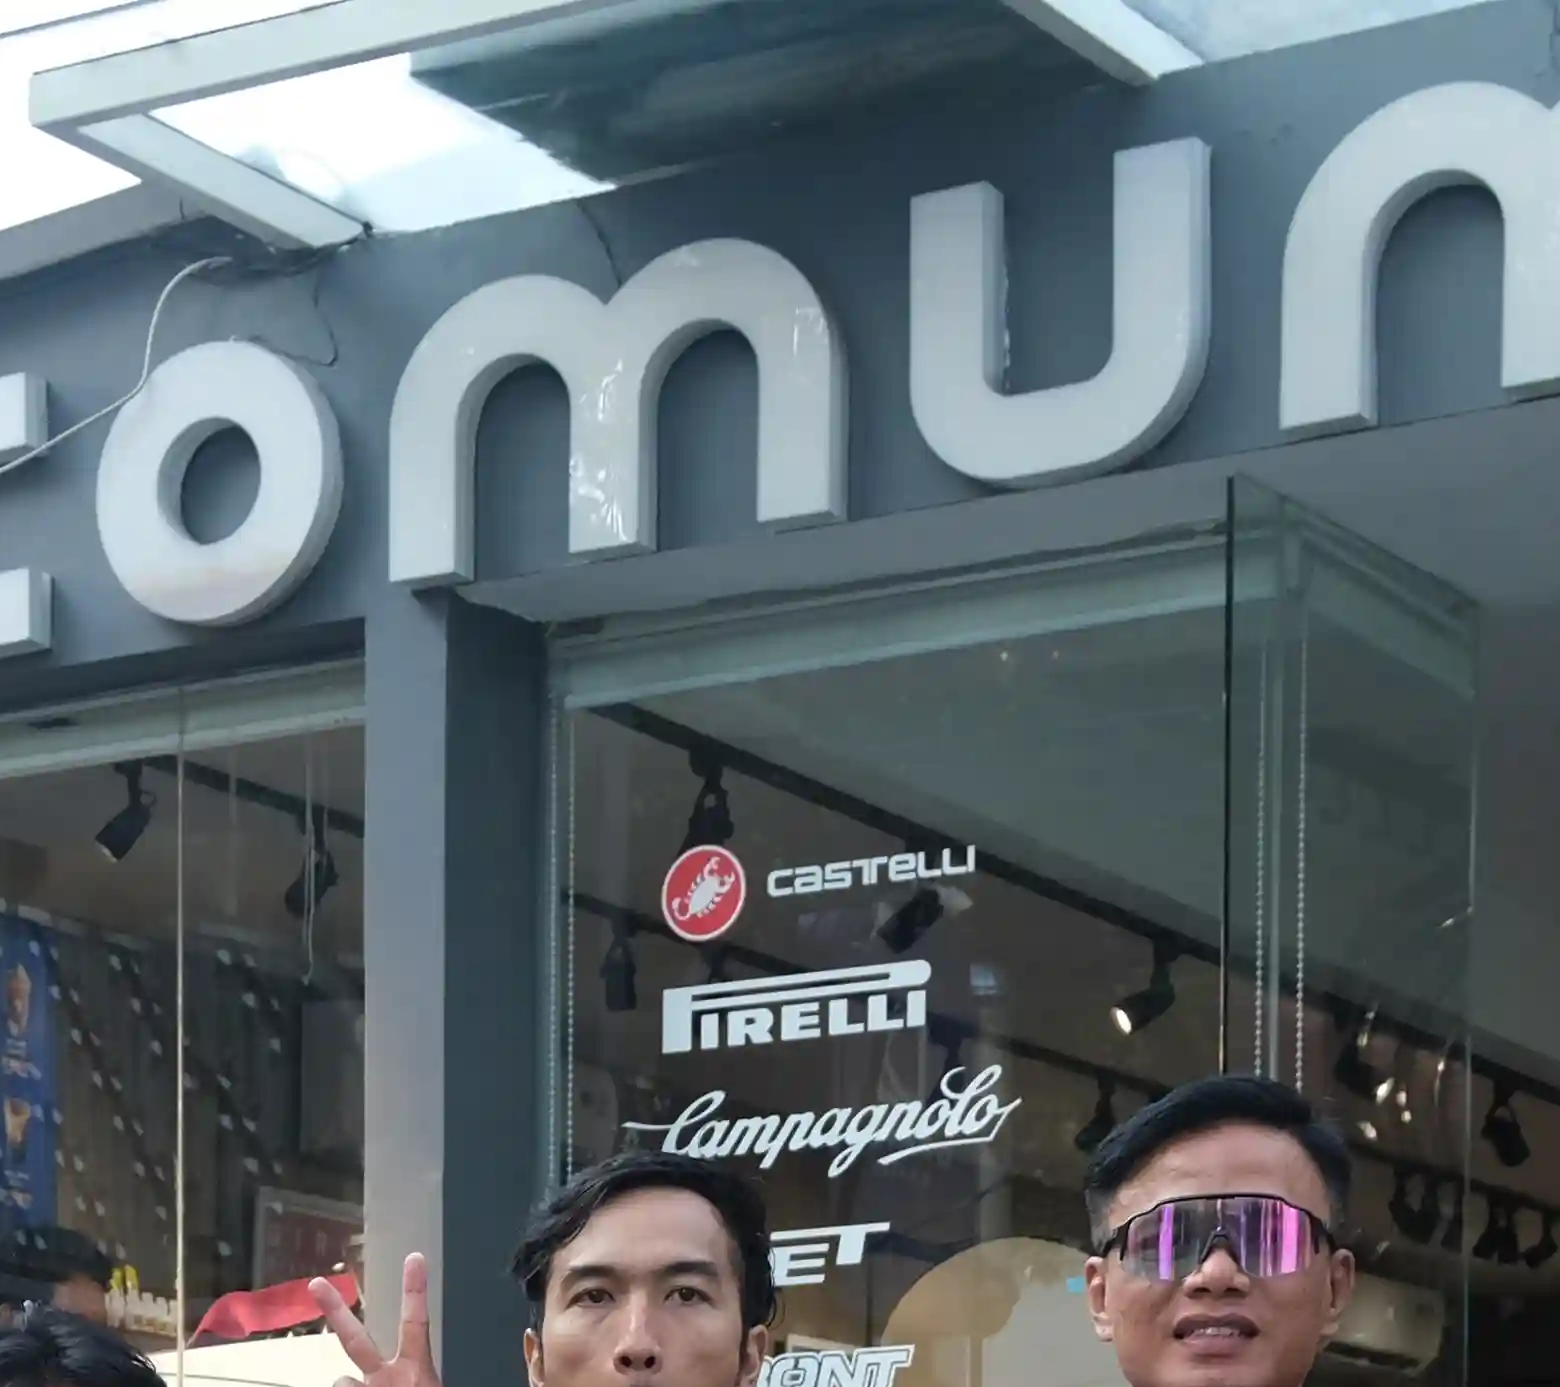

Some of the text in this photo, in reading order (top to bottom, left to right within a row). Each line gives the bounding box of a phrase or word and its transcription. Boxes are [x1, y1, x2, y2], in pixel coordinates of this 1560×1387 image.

[662, 960, 932, 1054] PIRELLI
[622, 1064, 1022, 1178] Campagnolo
[768, 1222, 890, 1287] ET
